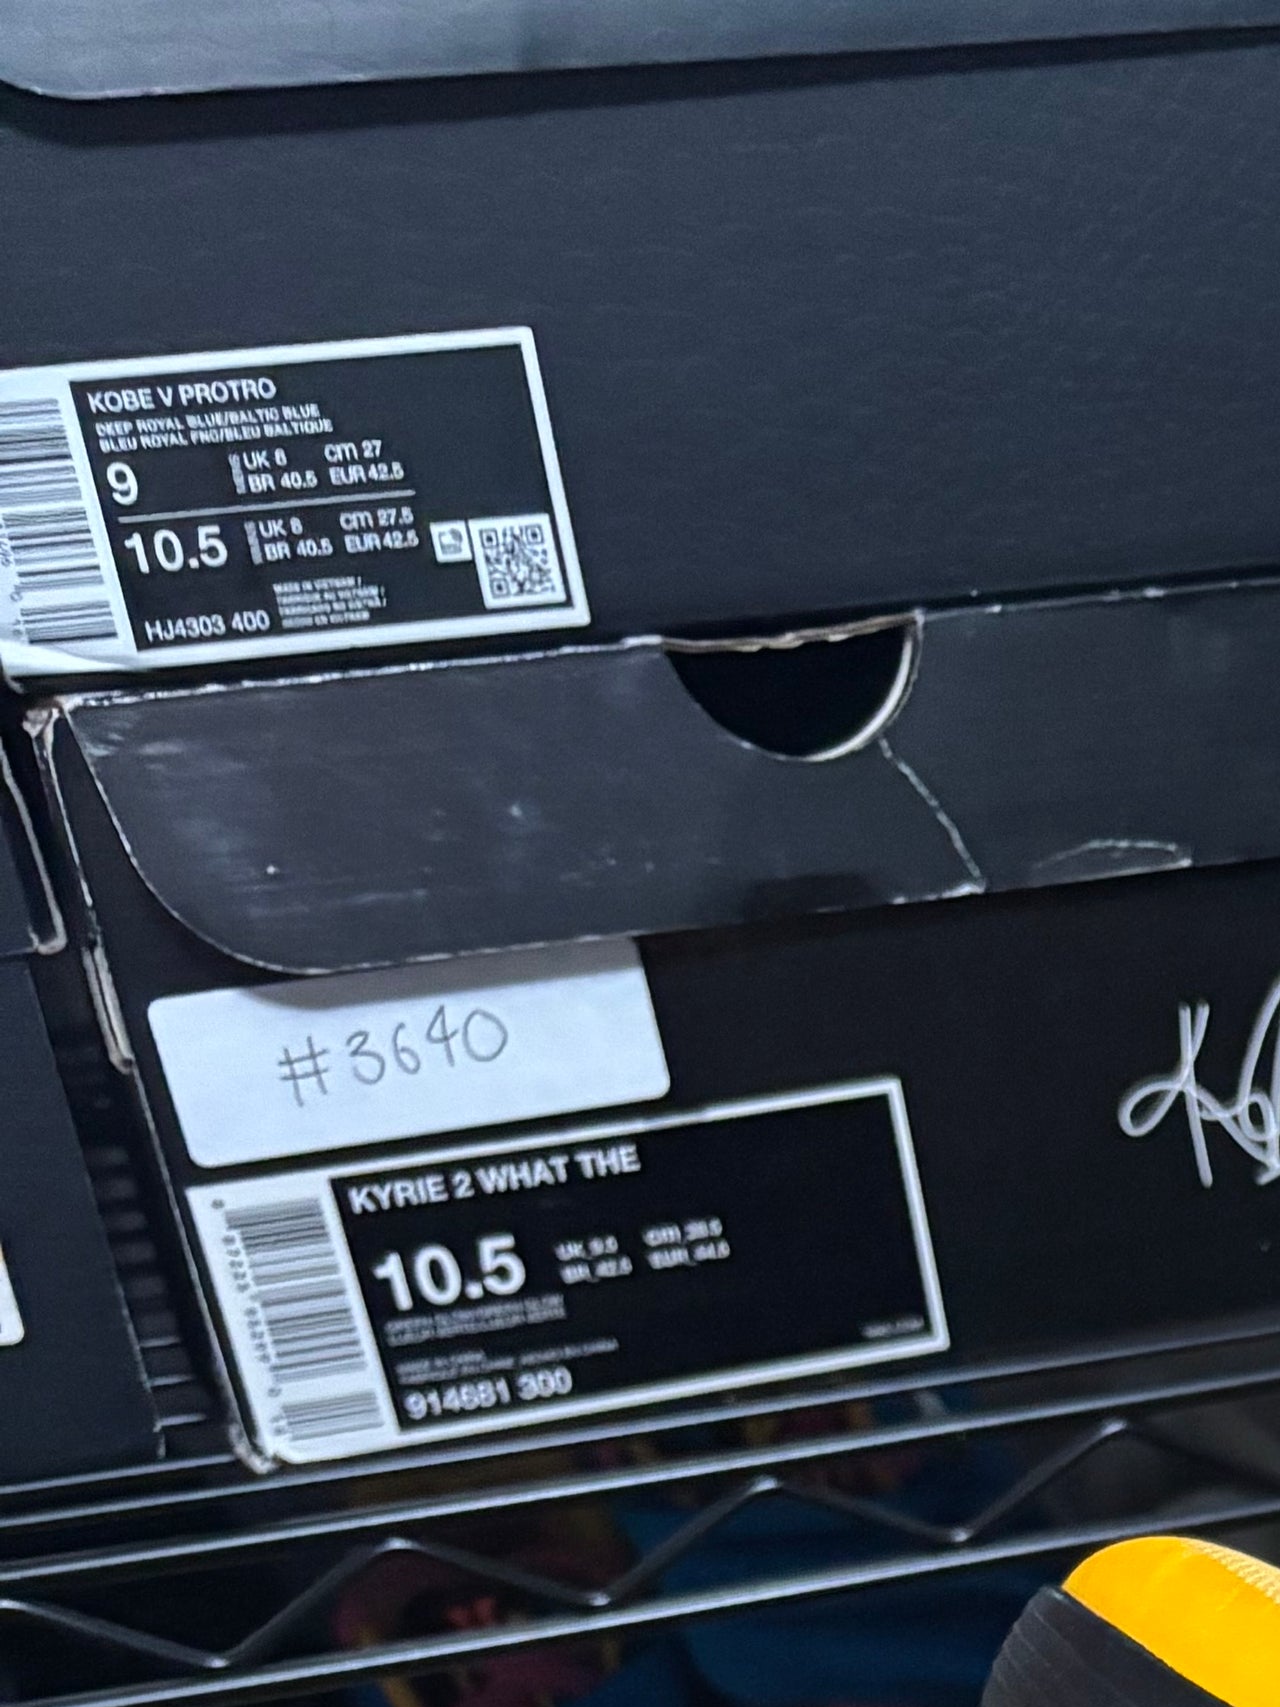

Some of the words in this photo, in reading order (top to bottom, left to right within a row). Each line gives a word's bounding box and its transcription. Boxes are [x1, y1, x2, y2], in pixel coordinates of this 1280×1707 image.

[88, 387, 154, 414] KOBE
[157, 387, 173, 407] V
[178, 377, 276, 406] PROTRO
[137, 415, 184, 432] ROYAL
[283, 403, 320, 421] BLUE
[100, 437, 137, 453] BLEU
[243, 451, 270, 471] UK
[324, 442, 358, 463] cm
[362, 440, 382, 458] 27
[106, 461, 138, 506] 9
[247, 473, 275, 493] BR
[329, 465, 367, 485] EUR
[258, 518, 287, 538] UK
[340, 511, 374, 531] cm
[124, 524, 228, 574] 10.5
[264, 541, 290, 561] BR
[344, 533, 381, 553] EUR
[144, 614, 226, 642] HJ4303
[231, 609, 270, 632] 400
[276, 1003, 509, 1108] #3640
[349, 1173, 448, 1216] KYRIE
[453, 1169, 474, 1199] 2
[475, 1155, 570, 1195] WHAT
[575, 1144, 641, 1180] THE
[373, 1232, 528, 1312] 10.5
